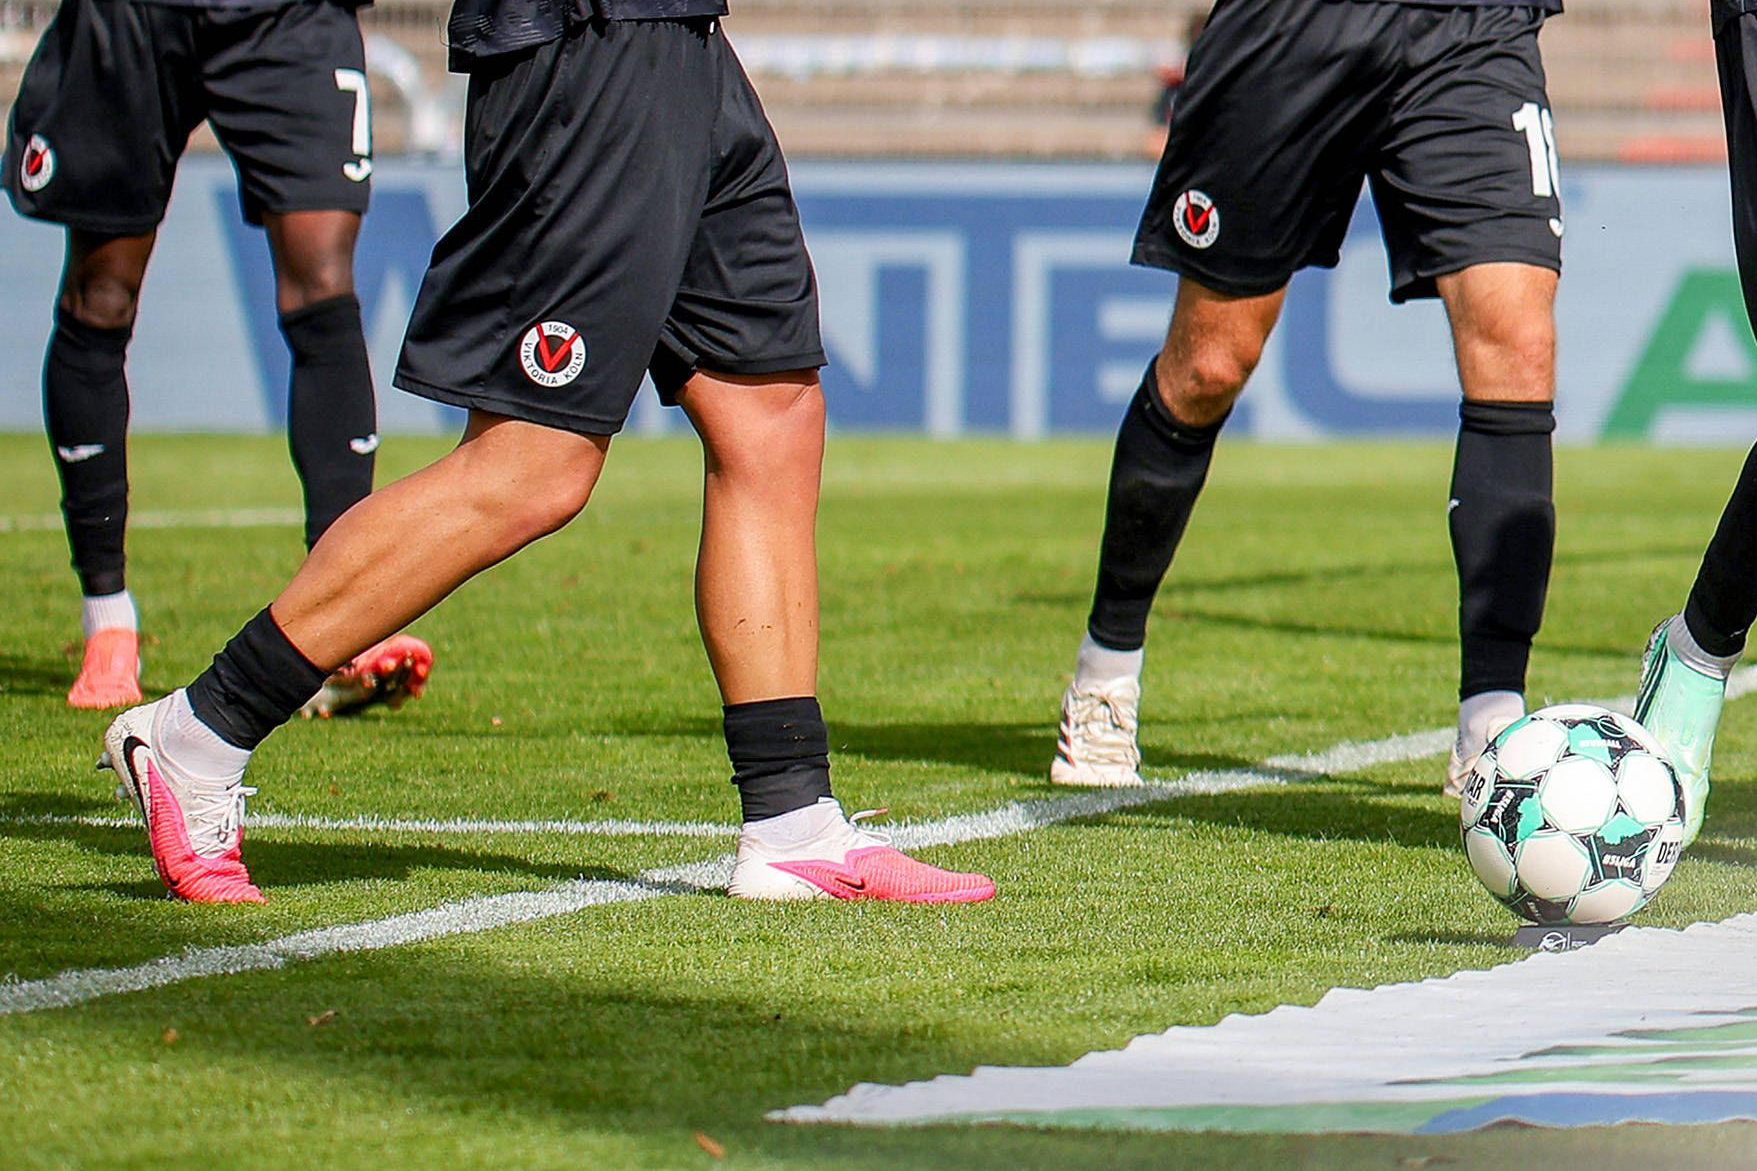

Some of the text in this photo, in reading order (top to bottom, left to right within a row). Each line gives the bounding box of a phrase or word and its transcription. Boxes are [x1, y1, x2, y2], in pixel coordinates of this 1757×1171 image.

[334, 68, 369, 155] 7
[547, 323, 569, 335] 1904
[523, 341, 559, 385] VIKTORIA
